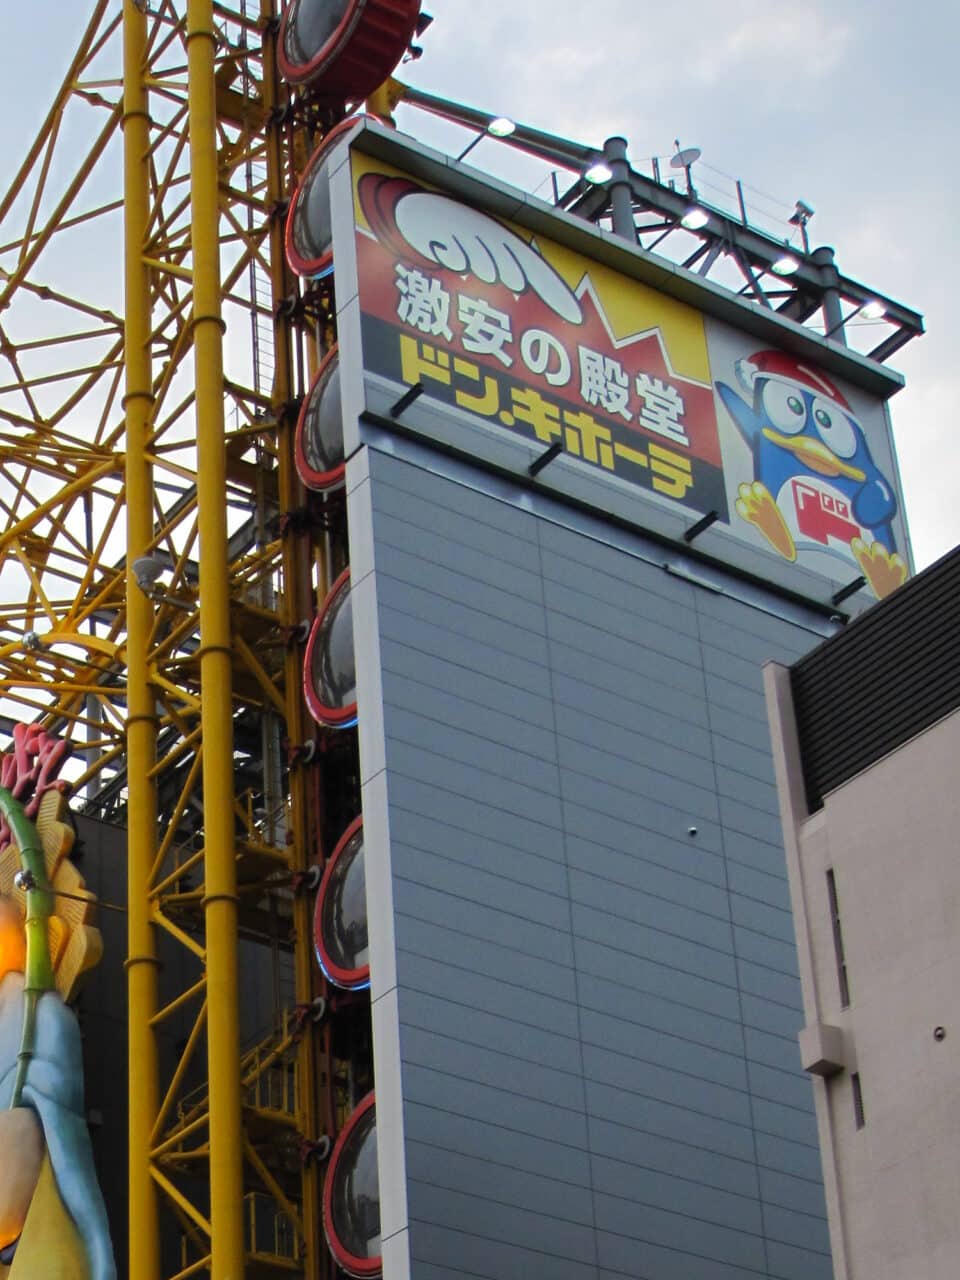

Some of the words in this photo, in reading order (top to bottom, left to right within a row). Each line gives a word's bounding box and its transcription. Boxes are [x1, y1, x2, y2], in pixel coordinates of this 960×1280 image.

[395, 262, 691, 447] 激安の殿堂
